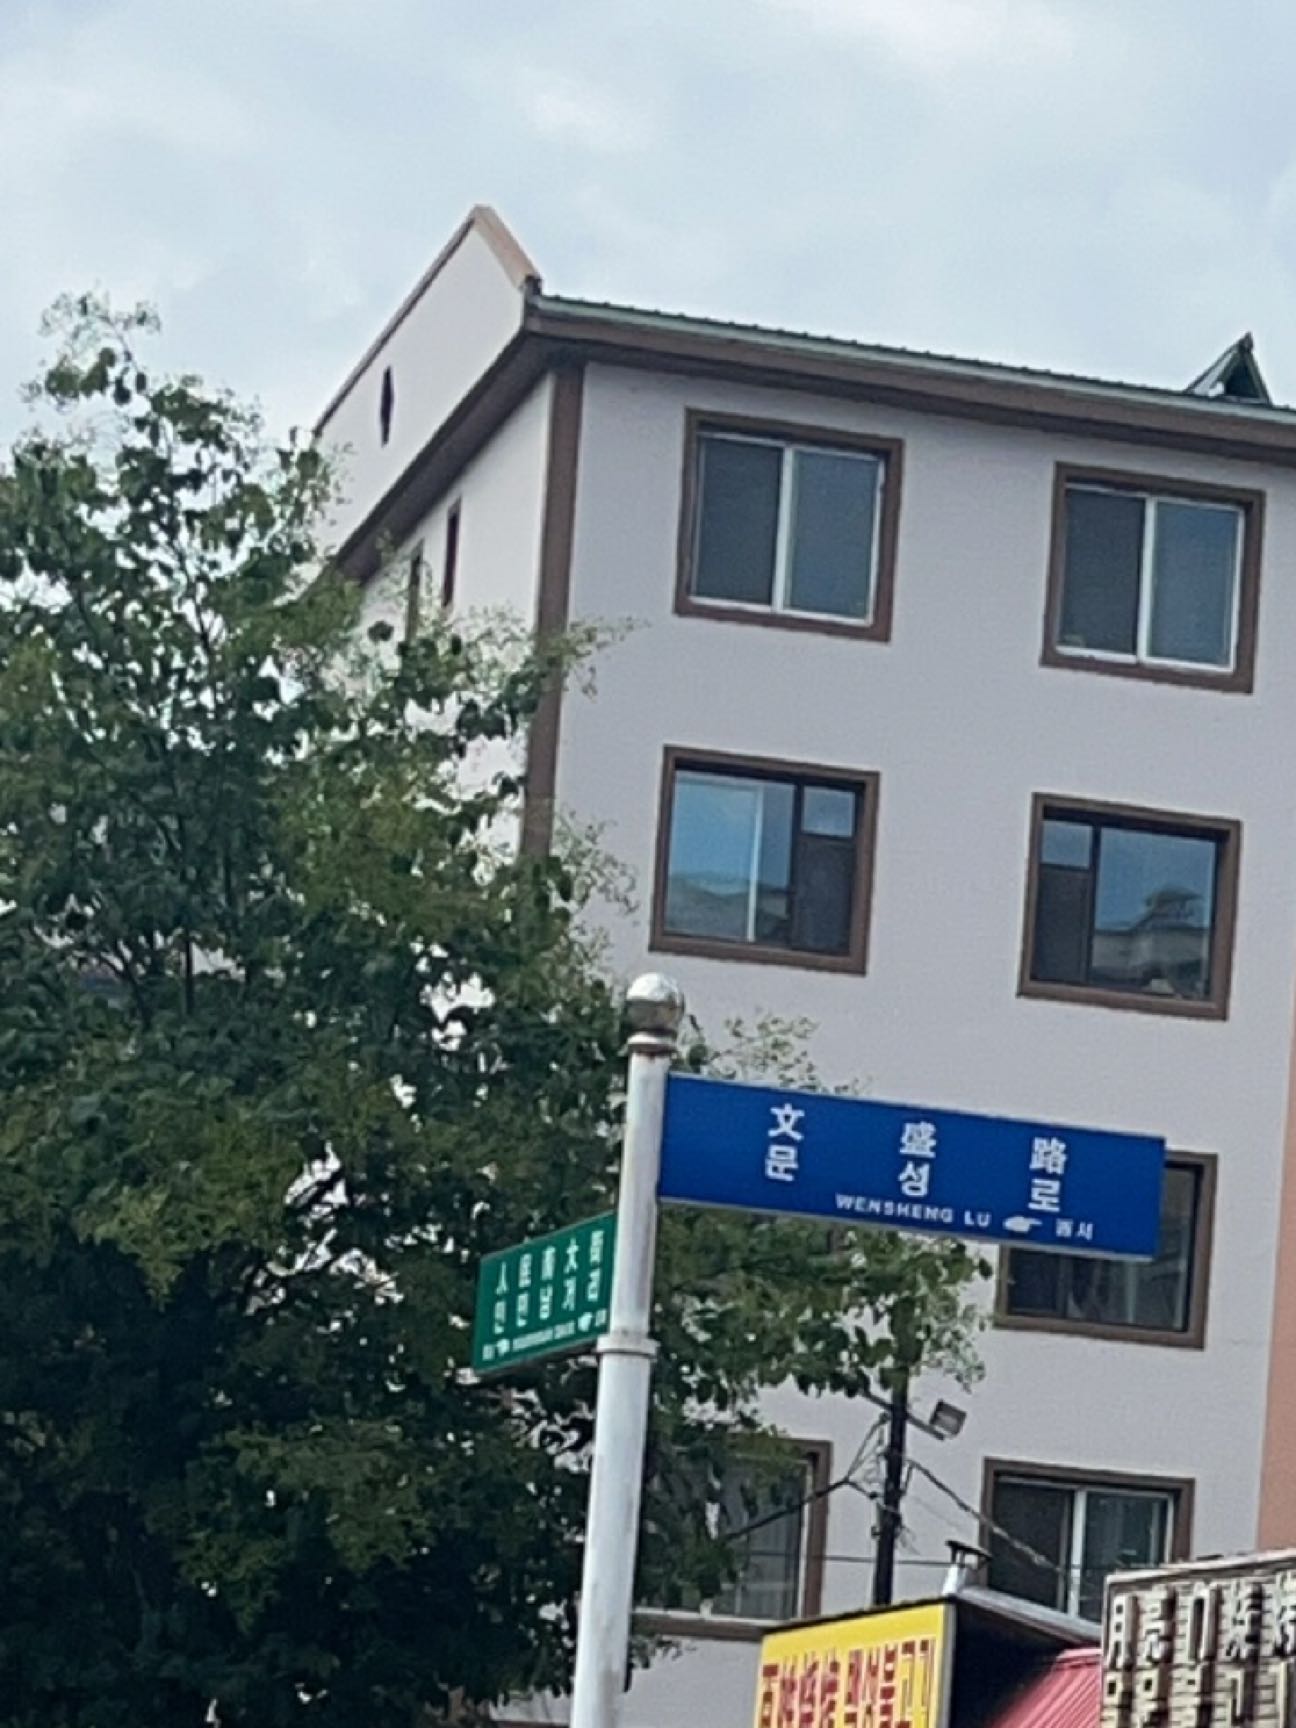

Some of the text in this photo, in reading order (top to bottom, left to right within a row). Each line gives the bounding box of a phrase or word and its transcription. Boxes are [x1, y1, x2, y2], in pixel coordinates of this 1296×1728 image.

[767, 1102, 1068, 1177] 文盛路
[764, 1144, 1062, 1213] 문성로
[834, 1193, 992, 1228] WENSHENG LU
